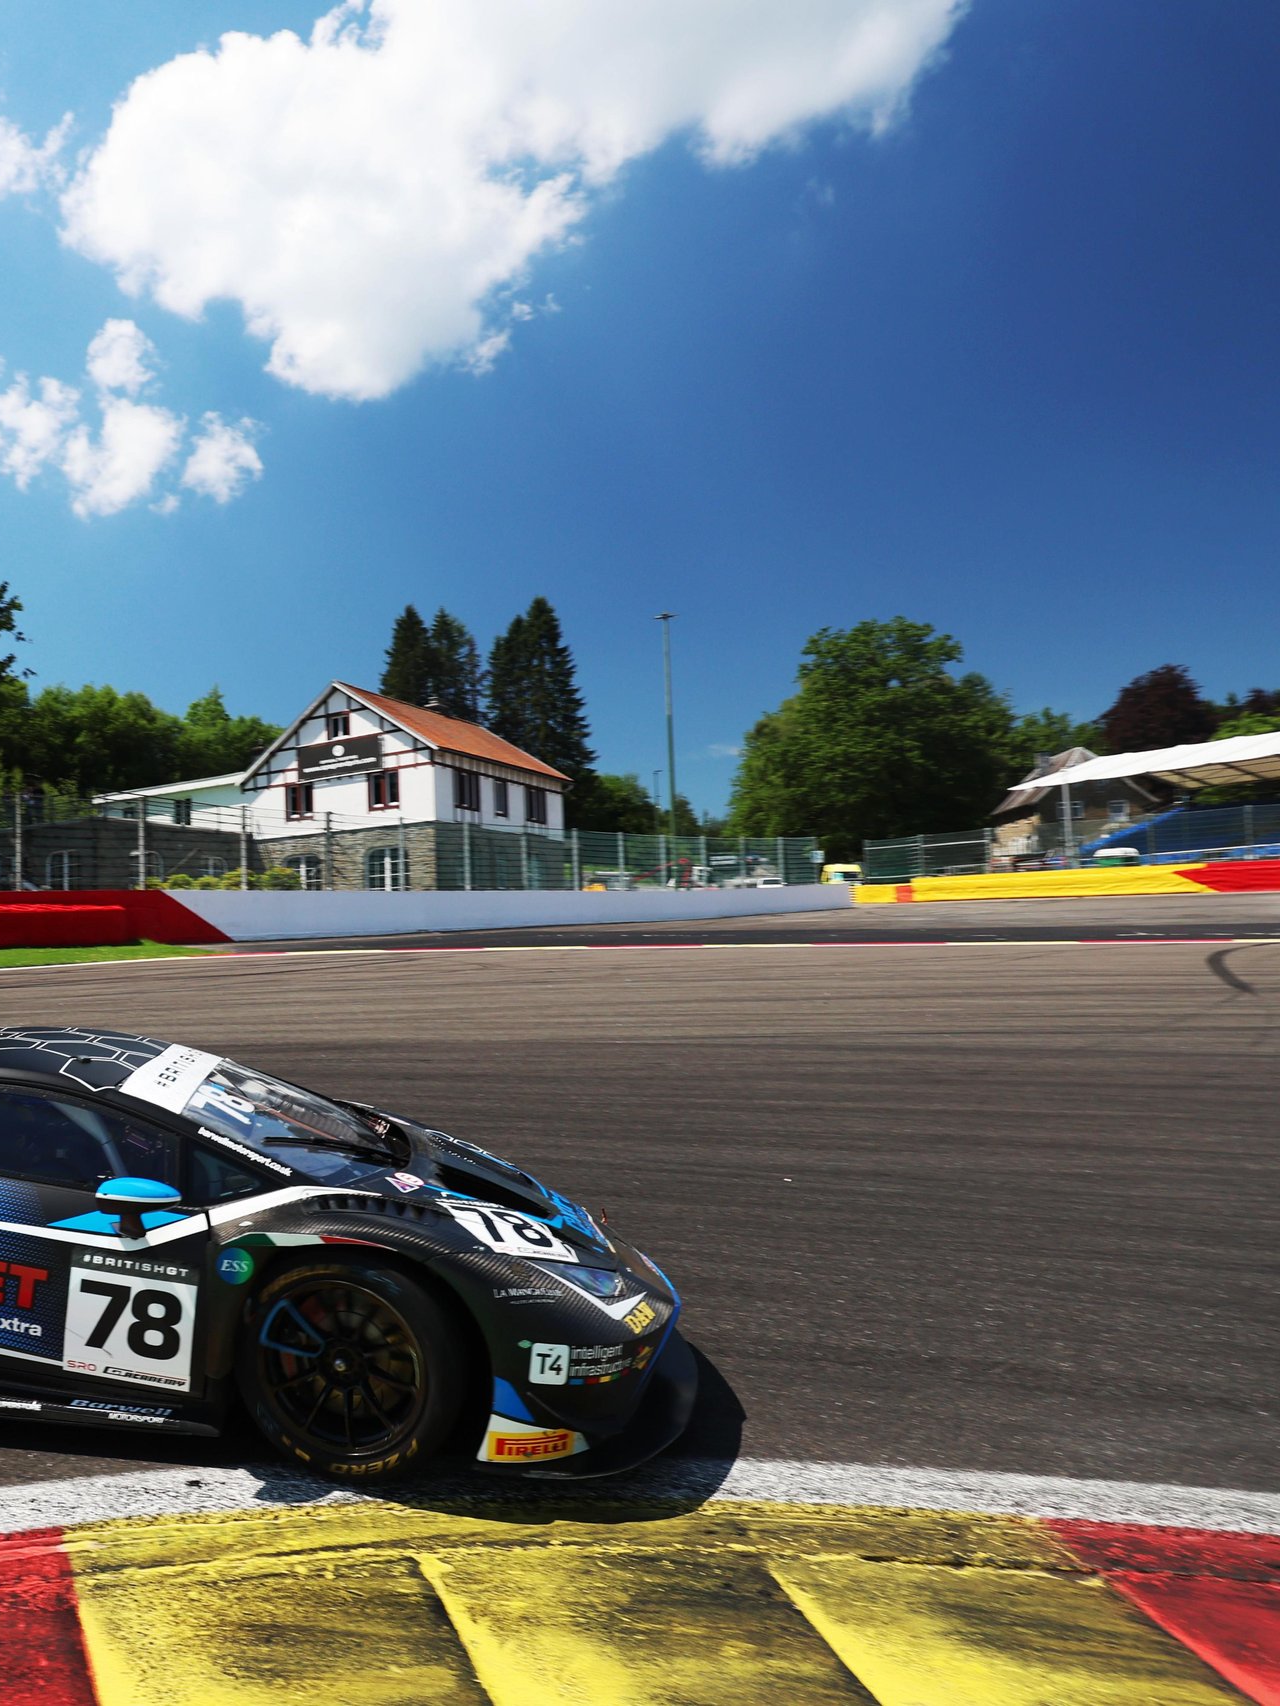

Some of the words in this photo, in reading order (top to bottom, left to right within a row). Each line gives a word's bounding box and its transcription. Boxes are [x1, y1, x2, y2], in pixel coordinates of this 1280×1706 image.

[447, 1203, 554, 1248] 78
[82, 1253, 190, 1277] #BRITISHGT
[220, 1258, 250, 1273] ESS
[79, 1278, 183, 1361] 78
[570, 1344, 623, 1362] intelligent
[66, 1360, 98, 1372] SRO
[535, 1352, 564, 1376] T4
[69, 1399, 174, 1416] Barwell
[107, 1411, 165, 1424] MOTORSPORT
[495, 1432, 569, 1456] PIRELLI
